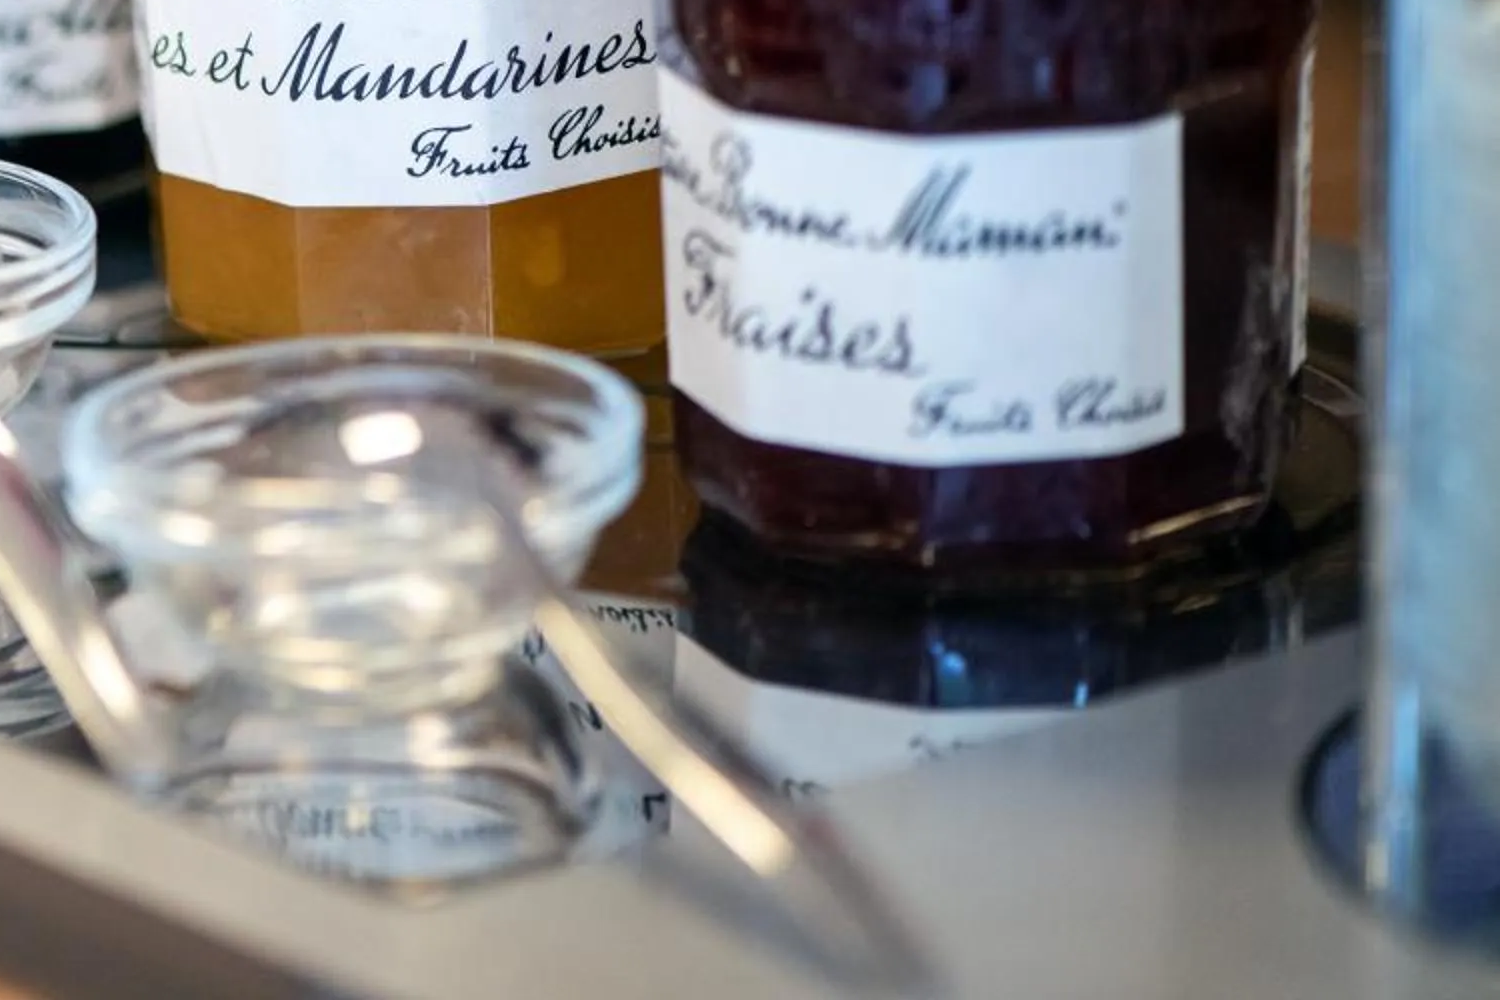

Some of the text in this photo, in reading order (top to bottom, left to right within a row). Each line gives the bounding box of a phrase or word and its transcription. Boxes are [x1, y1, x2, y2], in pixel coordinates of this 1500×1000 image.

[206, 30, 254, 91] et
[261, 18, 657, 103] Mandarines
[406, 103, 661, 178] Fruits Choisis
